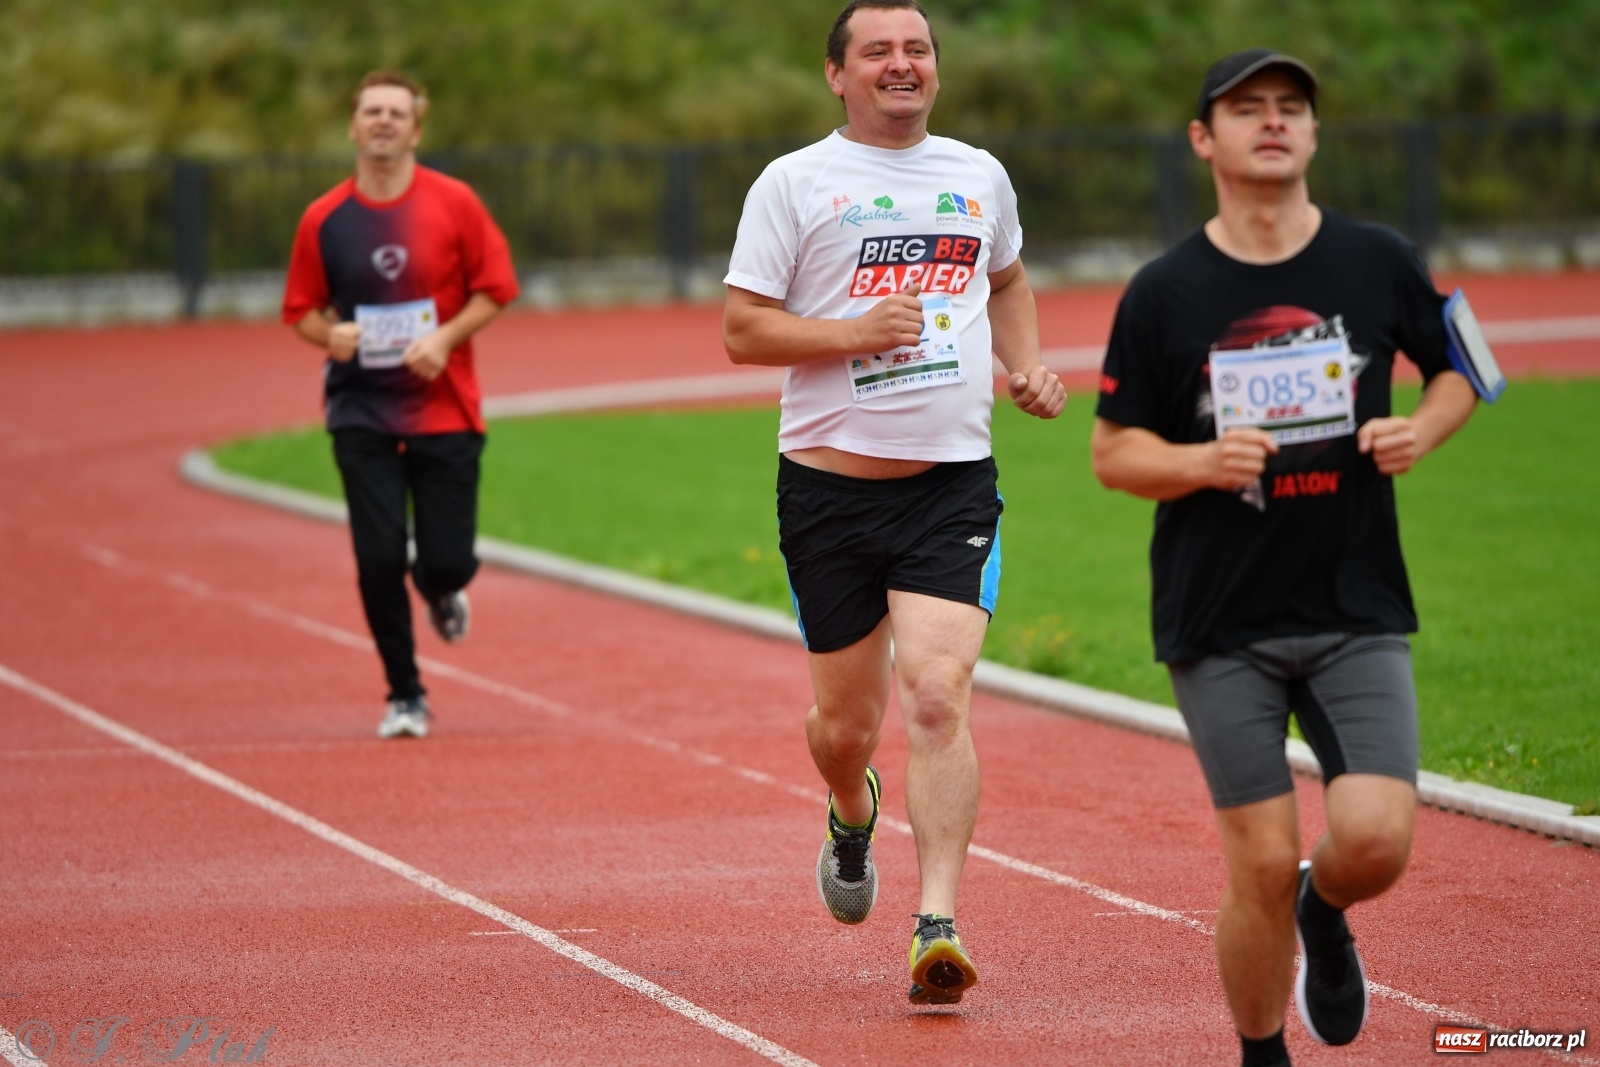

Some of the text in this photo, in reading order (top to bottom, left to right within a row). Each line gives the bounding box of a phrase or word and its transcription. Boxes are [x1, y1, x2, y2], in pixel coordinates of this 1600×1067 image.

[862, 237, 978, 263] BIEG BEZ
[852, 264, 970, 295] BARIER
[1247, 369, 1317, 408] 085
[966, 535, 989, 548] 4F
